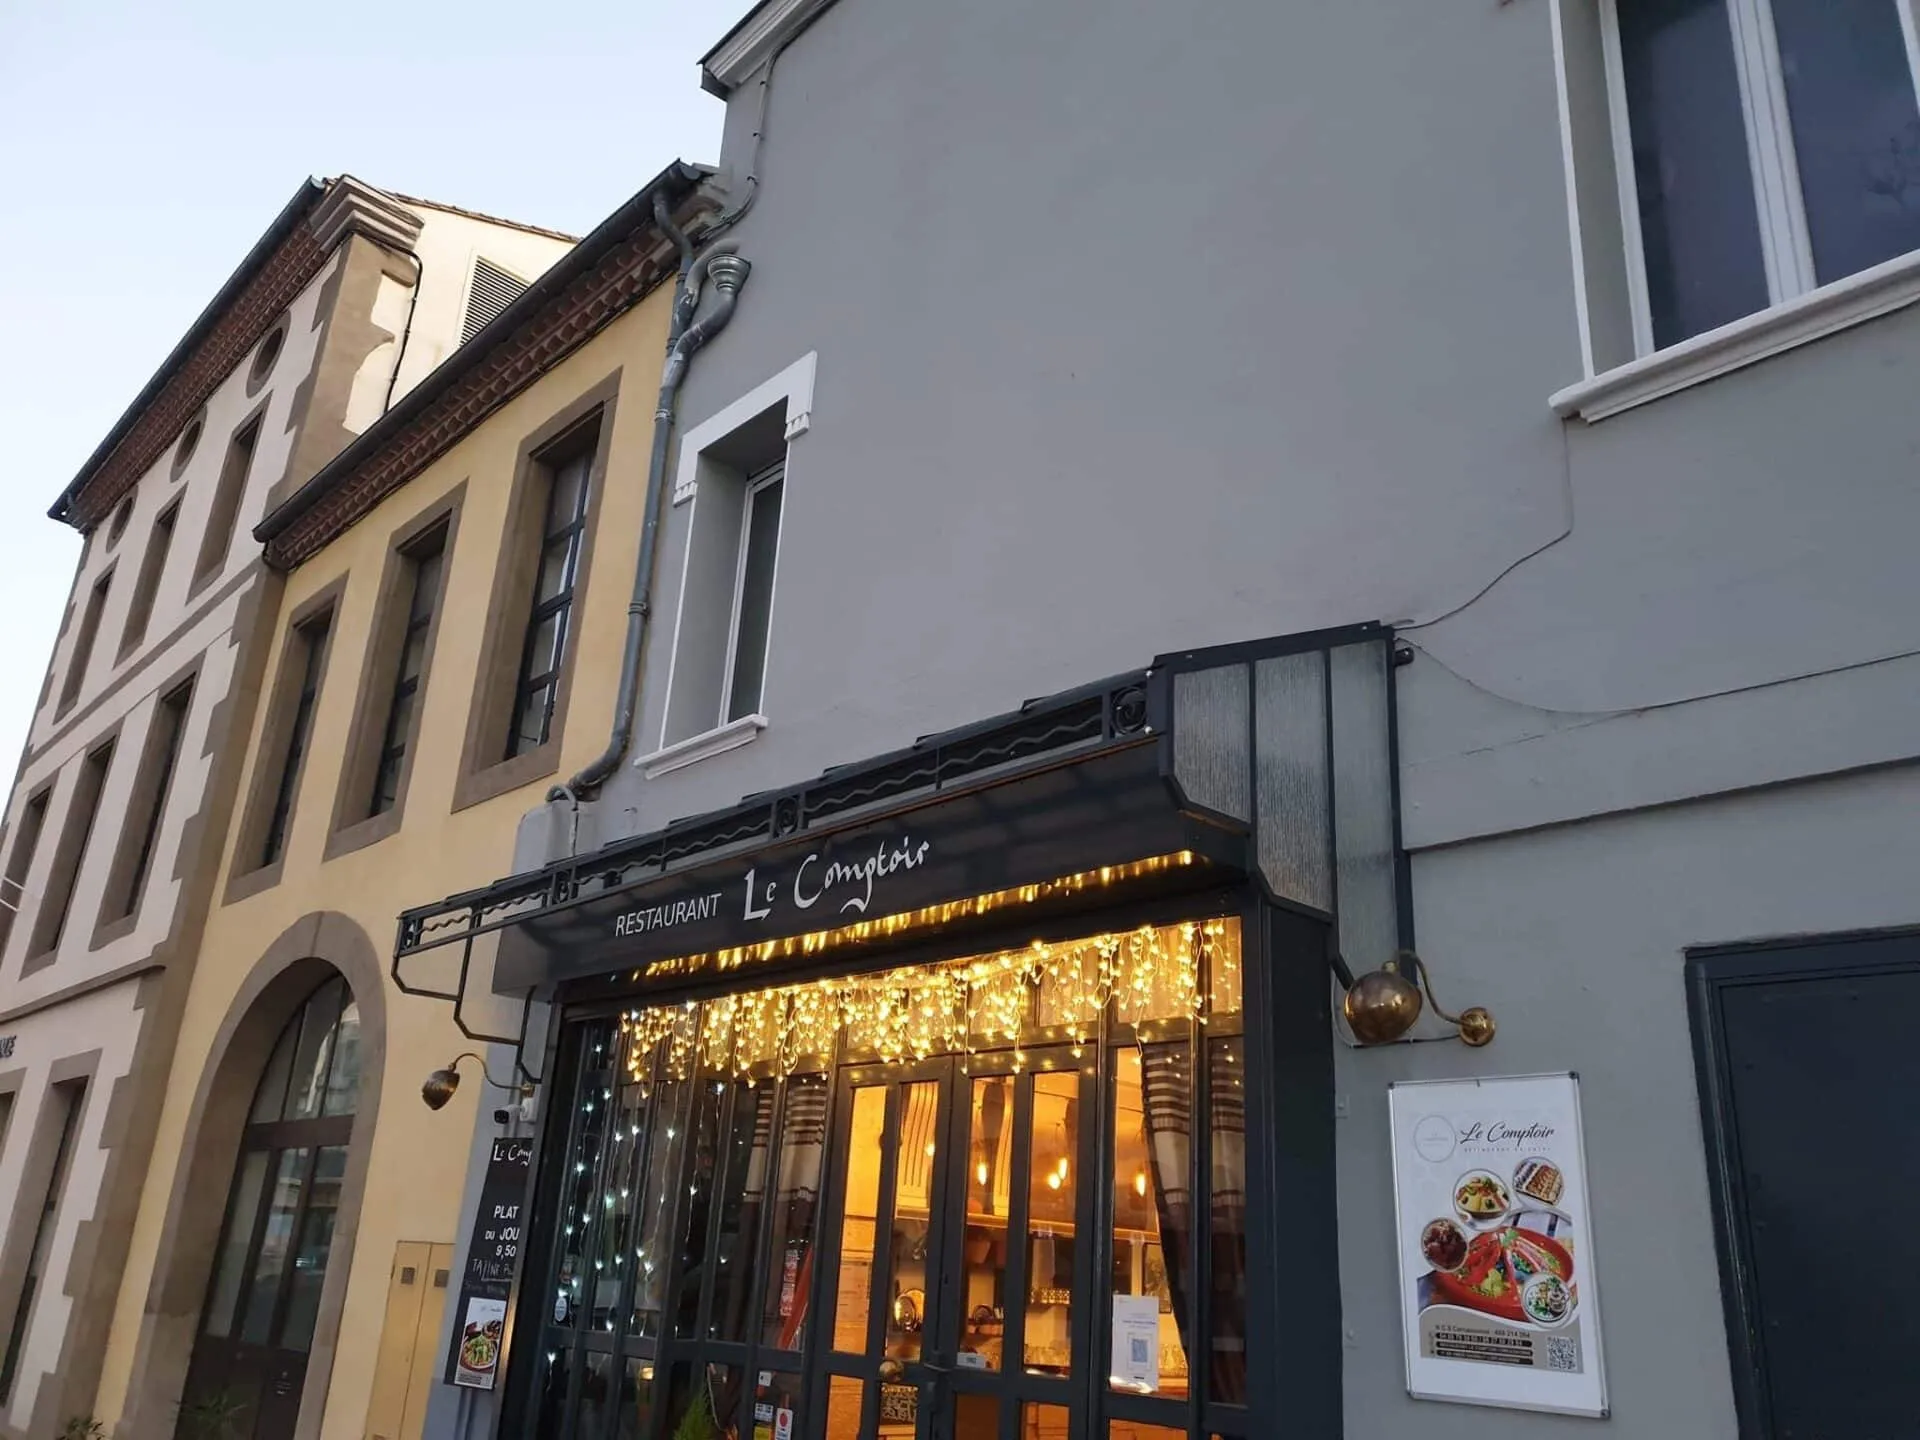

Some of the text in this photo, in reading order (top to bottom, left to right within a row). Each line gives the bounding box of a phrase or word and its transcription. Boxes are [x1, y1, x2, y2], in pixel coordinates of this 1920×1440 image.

[615, 835, 931, 937] RESTAURANT Le Comptoir
[1460, 1121, 1482, 1144] Le
[1488, 1121, 1555, 1147] Comptoir
[493, 1205, 520, 1219] PLAT
[495, 1244, 516, 1260] 9,50
